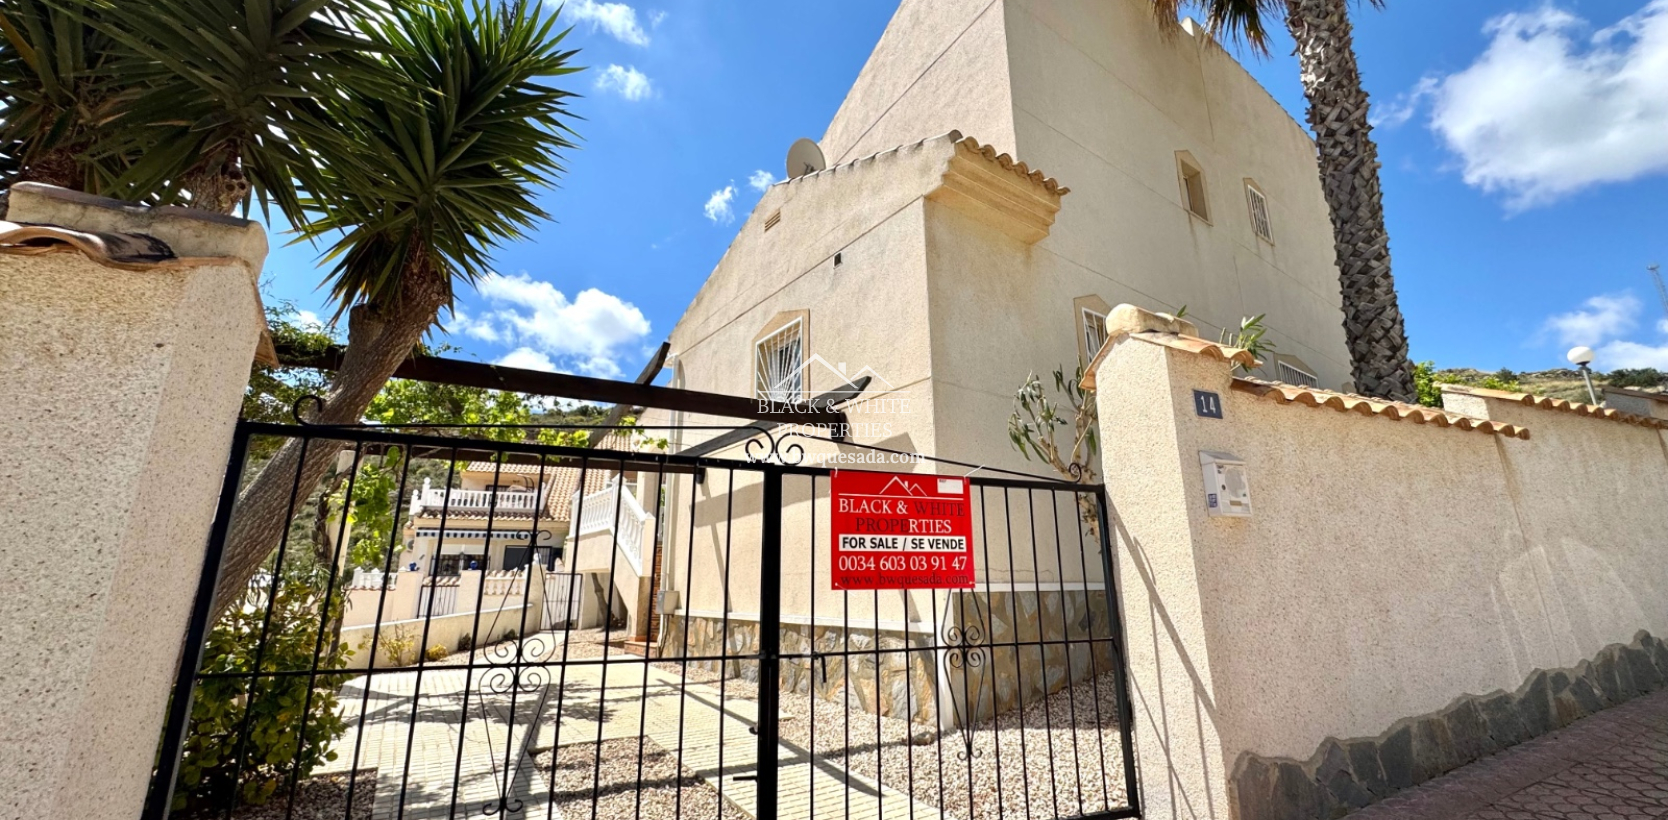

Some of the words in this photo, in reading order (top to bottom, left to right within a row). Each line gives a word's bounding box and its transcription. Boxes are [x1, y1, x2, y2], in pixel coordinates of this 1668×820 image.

[1200, 395, 1216, 414] 14
[838, 498, 892, 514] BLACK
[896, 500, 908, 514] &
[914, 501, 965, 516] WHITE
[855, 517, 952, 533] PROPERTIES
[842, 536, 866, 549] FOR
[869, 537, 898, 549] SALE
[902, 537, 907, 551] /
[911, 538, 925, 549] SE
[928, 538, 964, 550] VENDE
[838, 555, 876, 571] 0034
[879, 555, 906, 571] 603
[910, 555, 927, 571] 03
[931, 555, 947, 571] 91
[951, 556, 967, 571] 47
[840, 573, 969, 588] www.bwquesada.com
